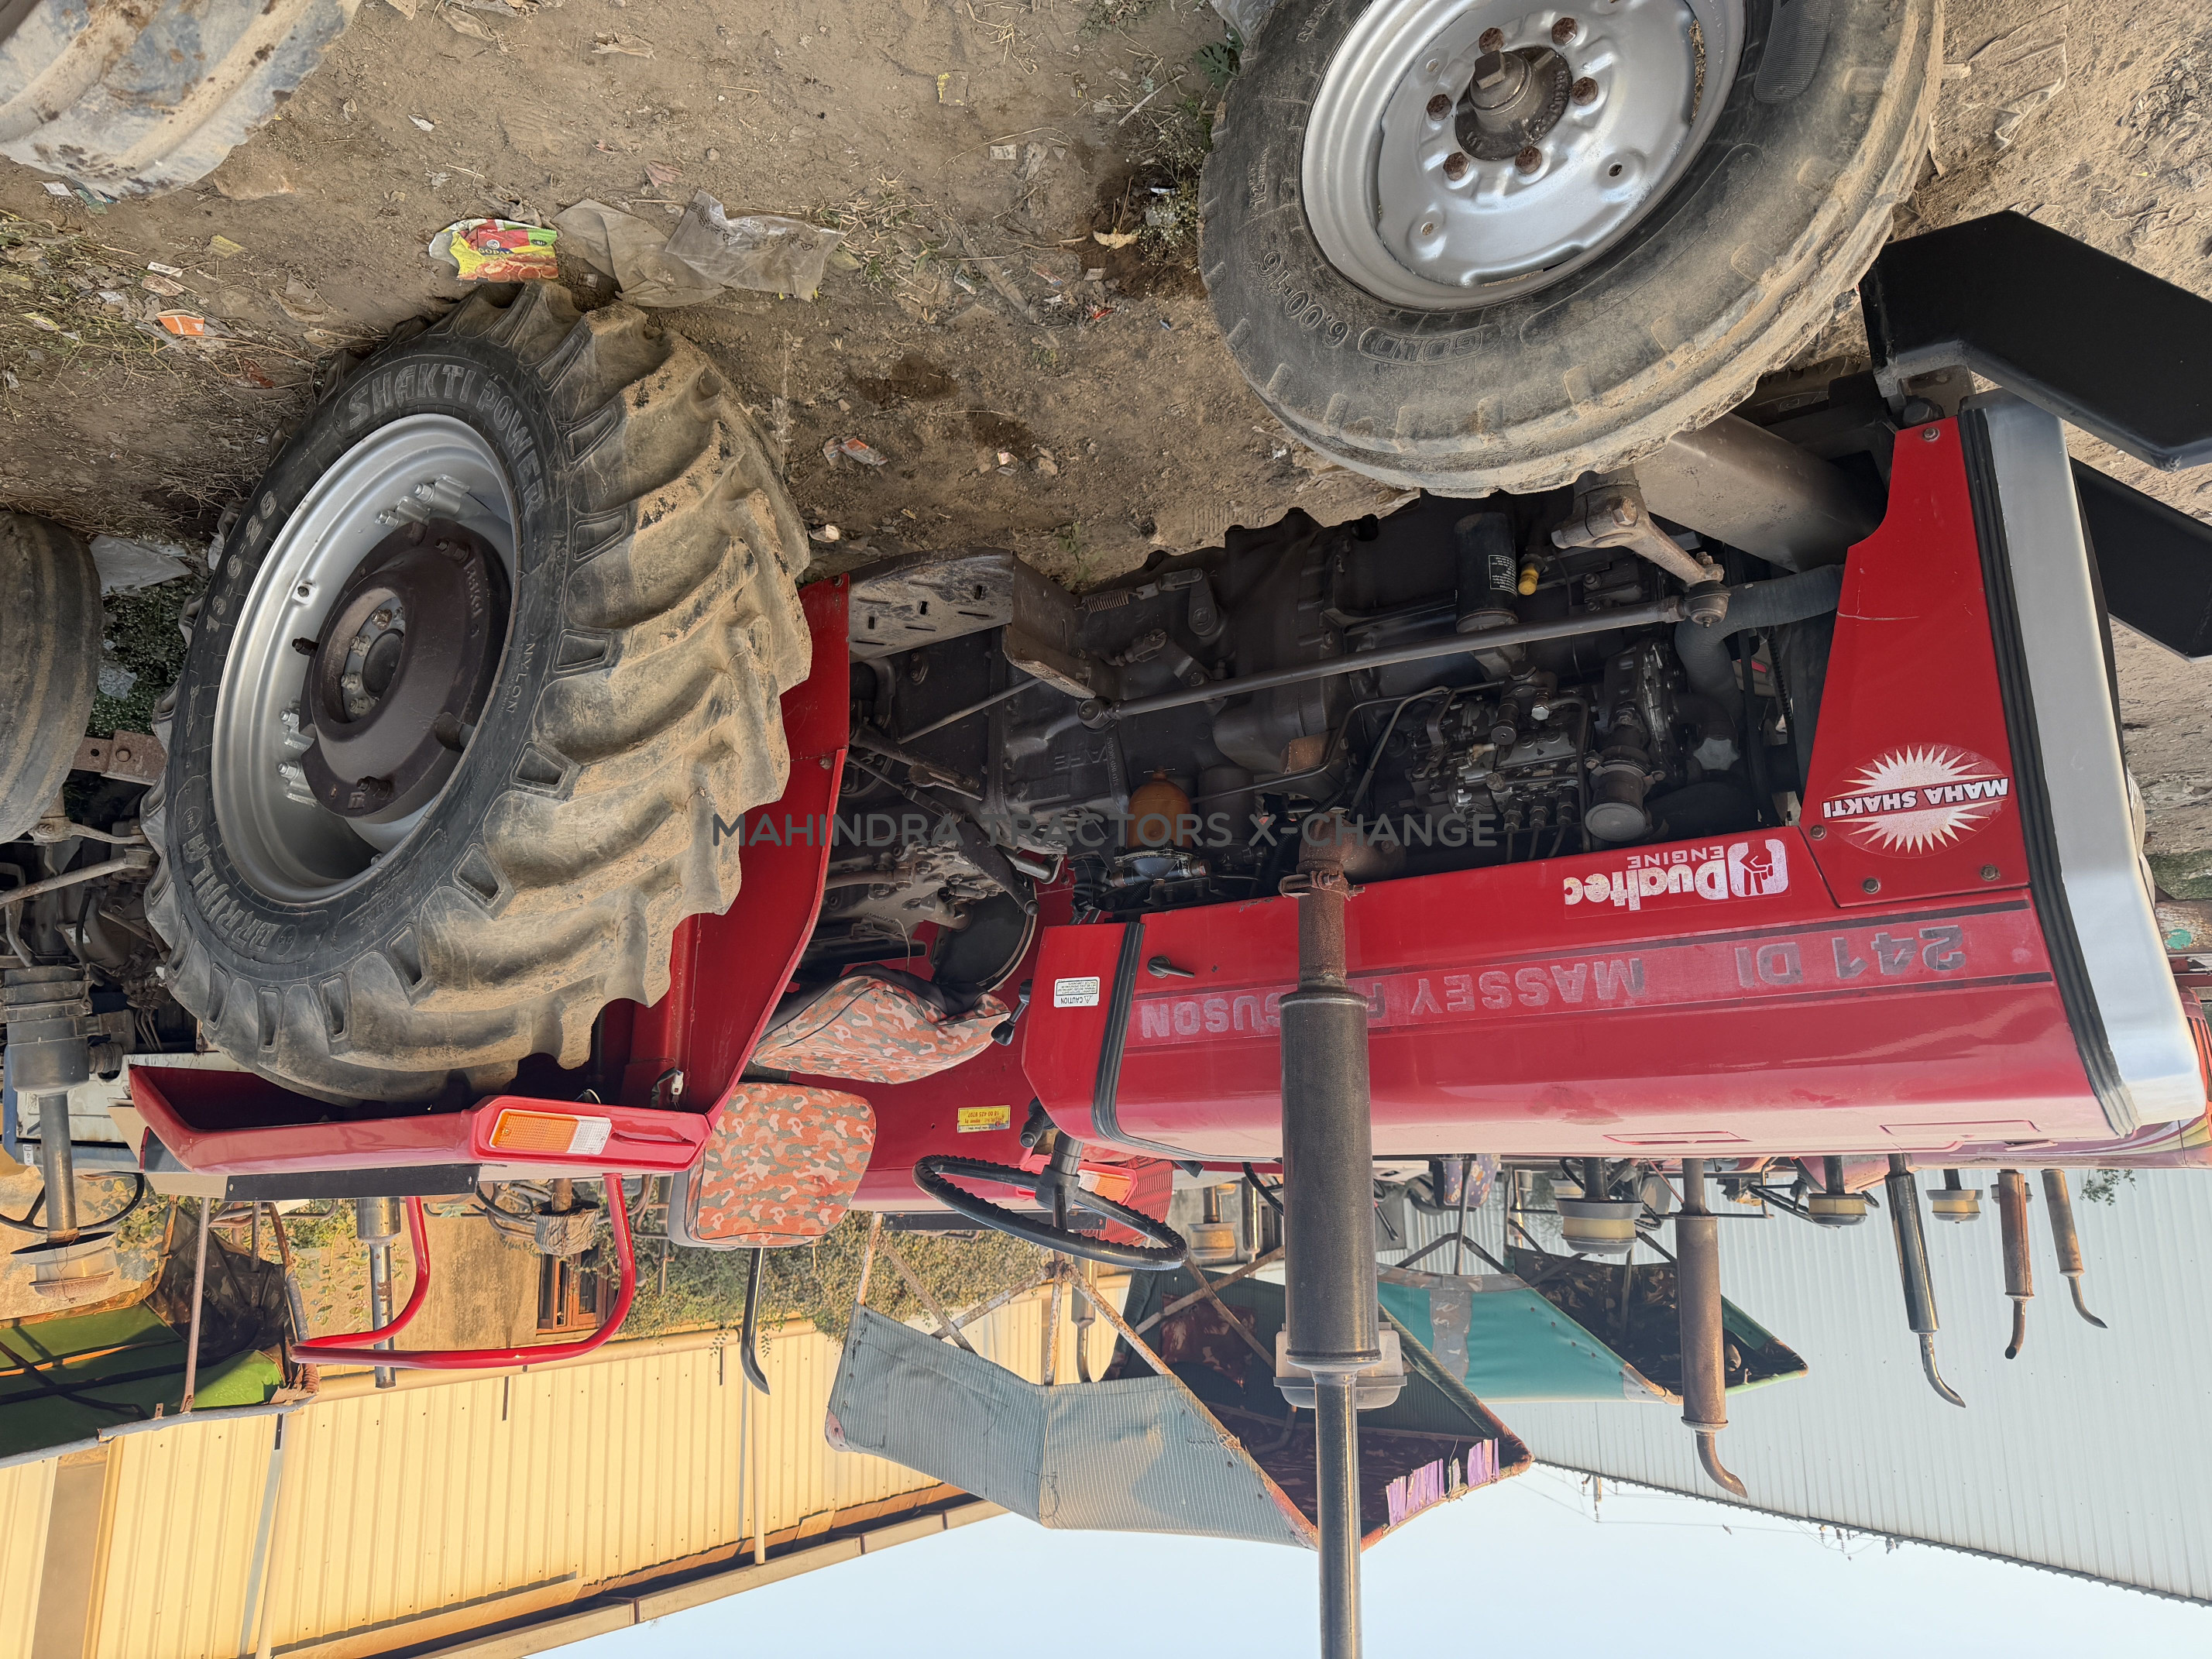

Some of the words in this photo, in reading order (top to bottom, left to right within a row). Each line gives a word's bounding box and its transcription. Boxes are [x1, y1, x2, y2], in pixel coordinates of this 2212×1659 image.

[1256, 250, 1348, 348] 6.00-16
[1372, 331, 1482, 362] GOLD
[349, 363, 476, 430] SHAKTI
[476, 380, 543, 522] POWER
[1822, 790, 1918, 819] SHAKTI
[1922, 778, 2009, 805] MAHA
[1626, 845, 1725, 868] ENGINE
[1563, 860, 1729, 911] Dualtec
[1734, 942, 1802, 988] DI
[1831, 924, 1966, 980] 241
[1141, 984, 1386, 1039] FGUSON
[1411, 958, 1645, 1015] MASSEY
